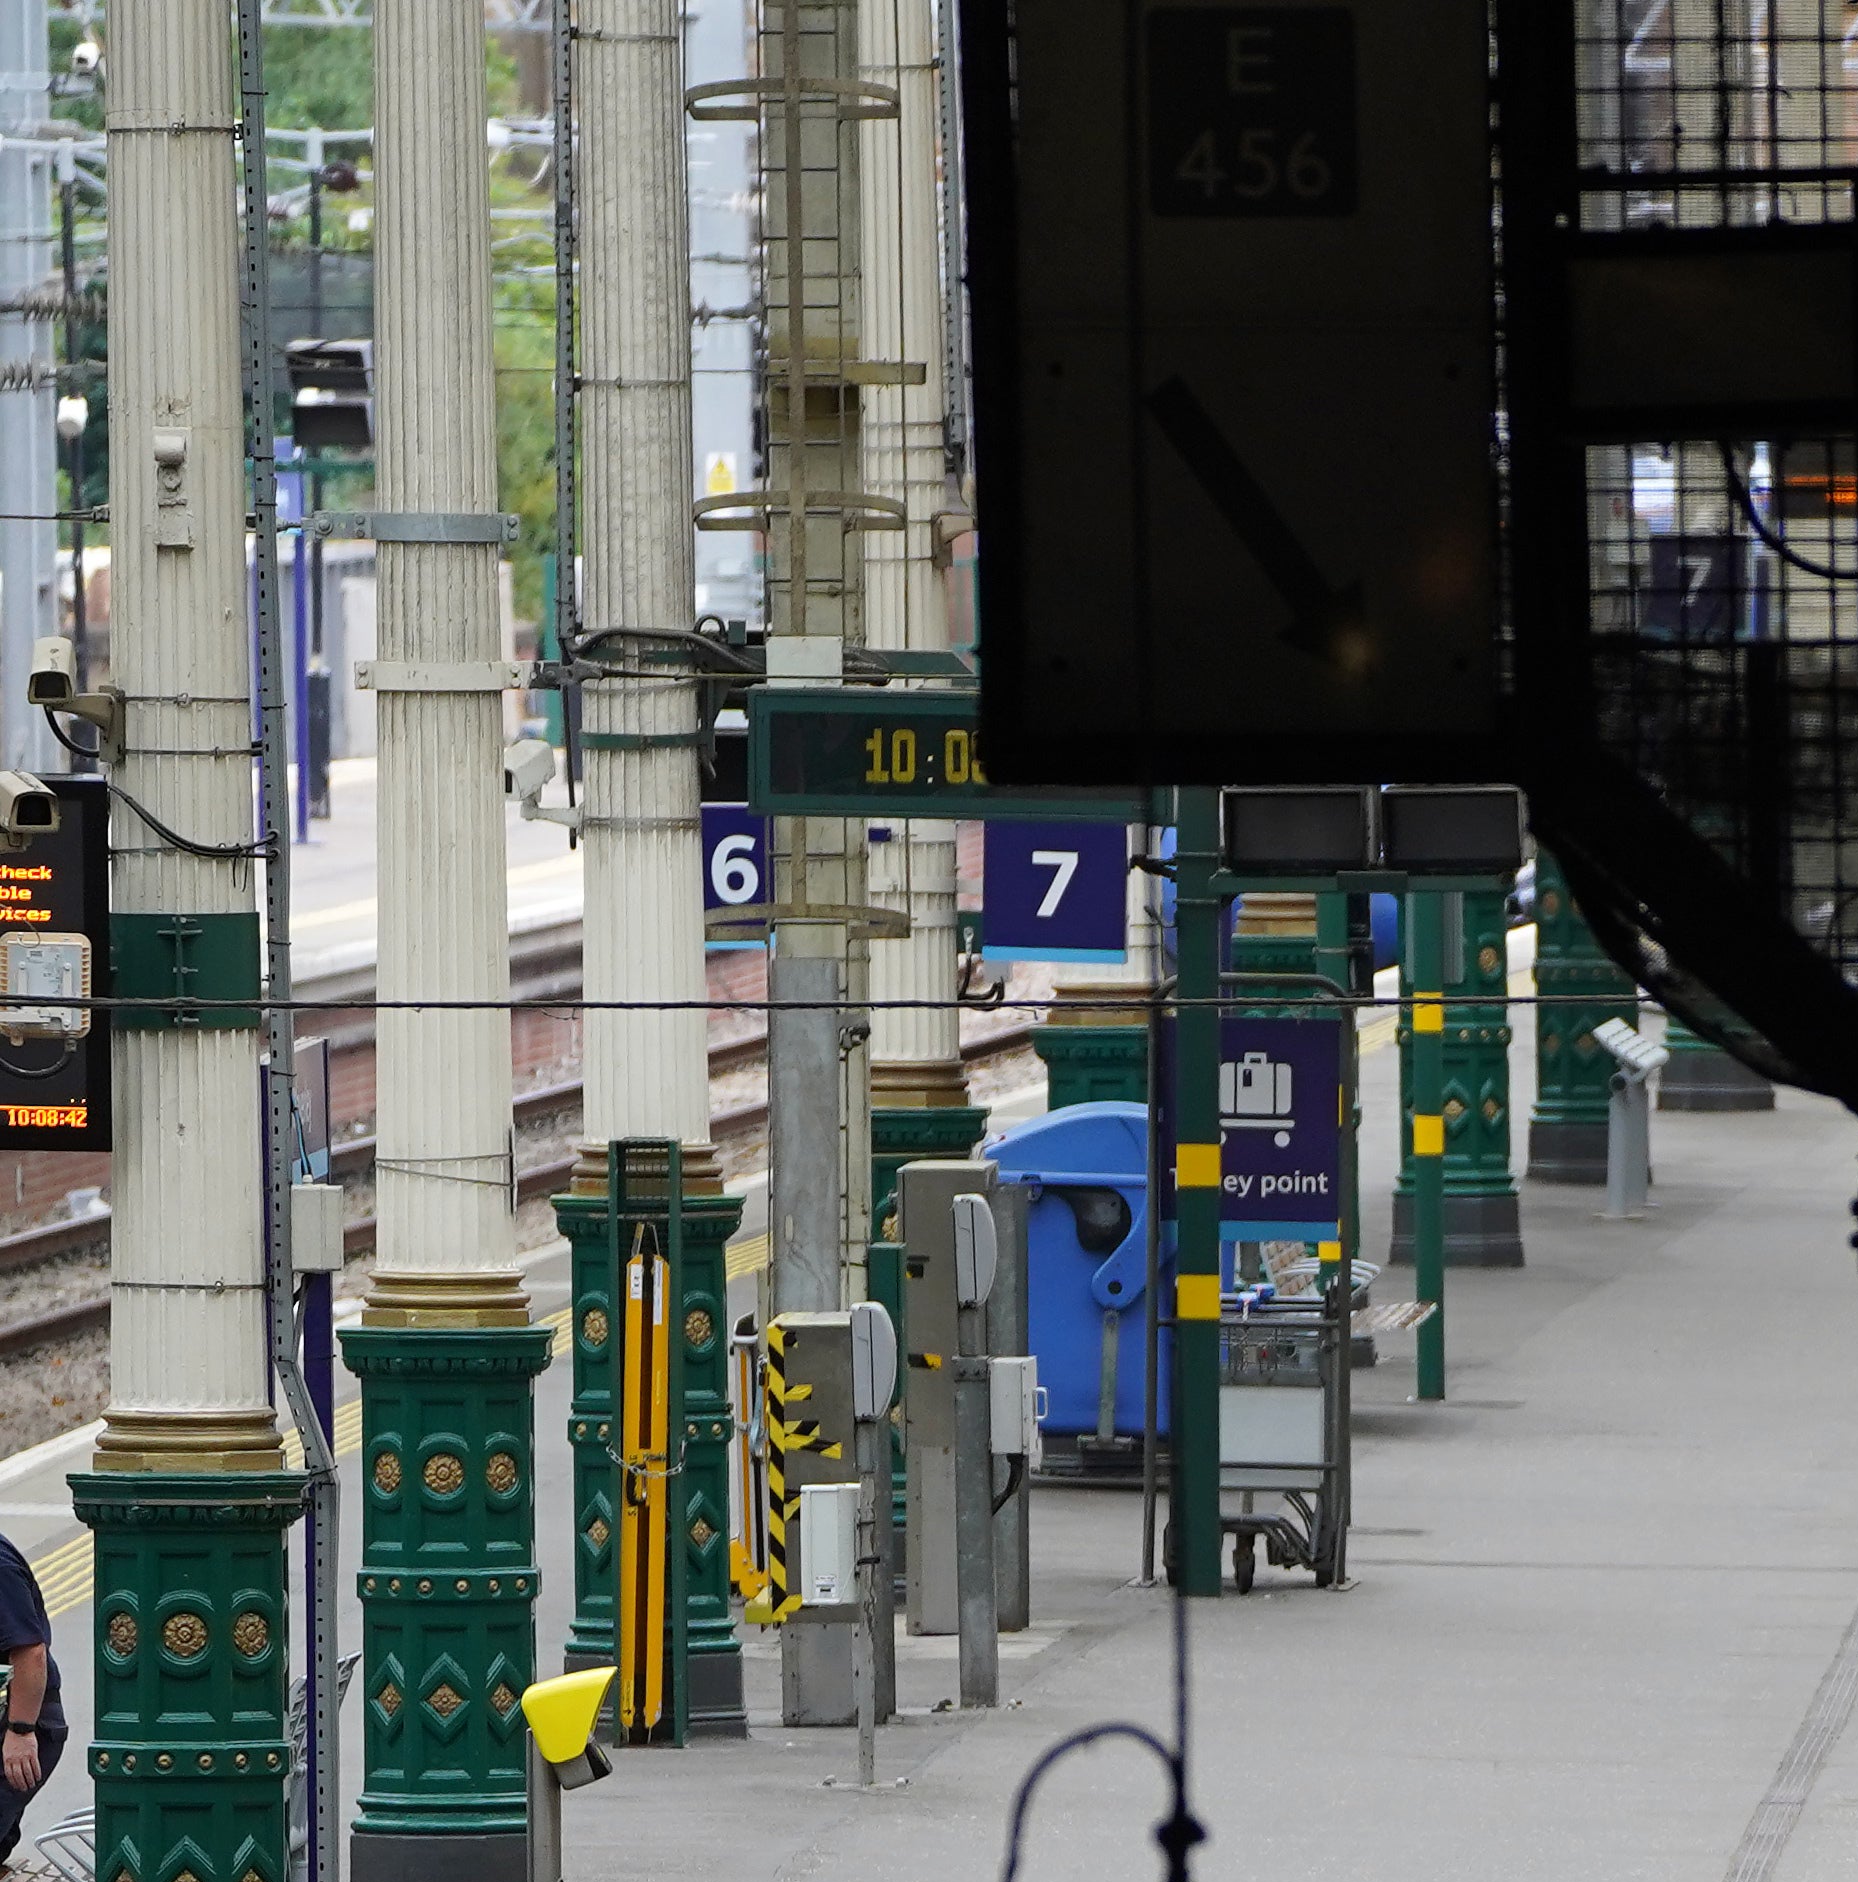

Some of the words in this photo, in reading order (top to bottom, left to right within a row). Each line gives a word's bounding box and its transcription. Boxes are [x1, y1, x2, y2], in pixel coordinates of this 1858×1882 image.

[1227, 28, 1276, 92] E
[1176, 128, 1332, 199] 456
[1677, 555, 1712, 607] 7
[711, 834, 759, 904] 6
[1031, 850, 1079, 917] 7
[8, 1108, 88, 1127] 10:08:42
[1260, 1169, 1329, 1198] point
